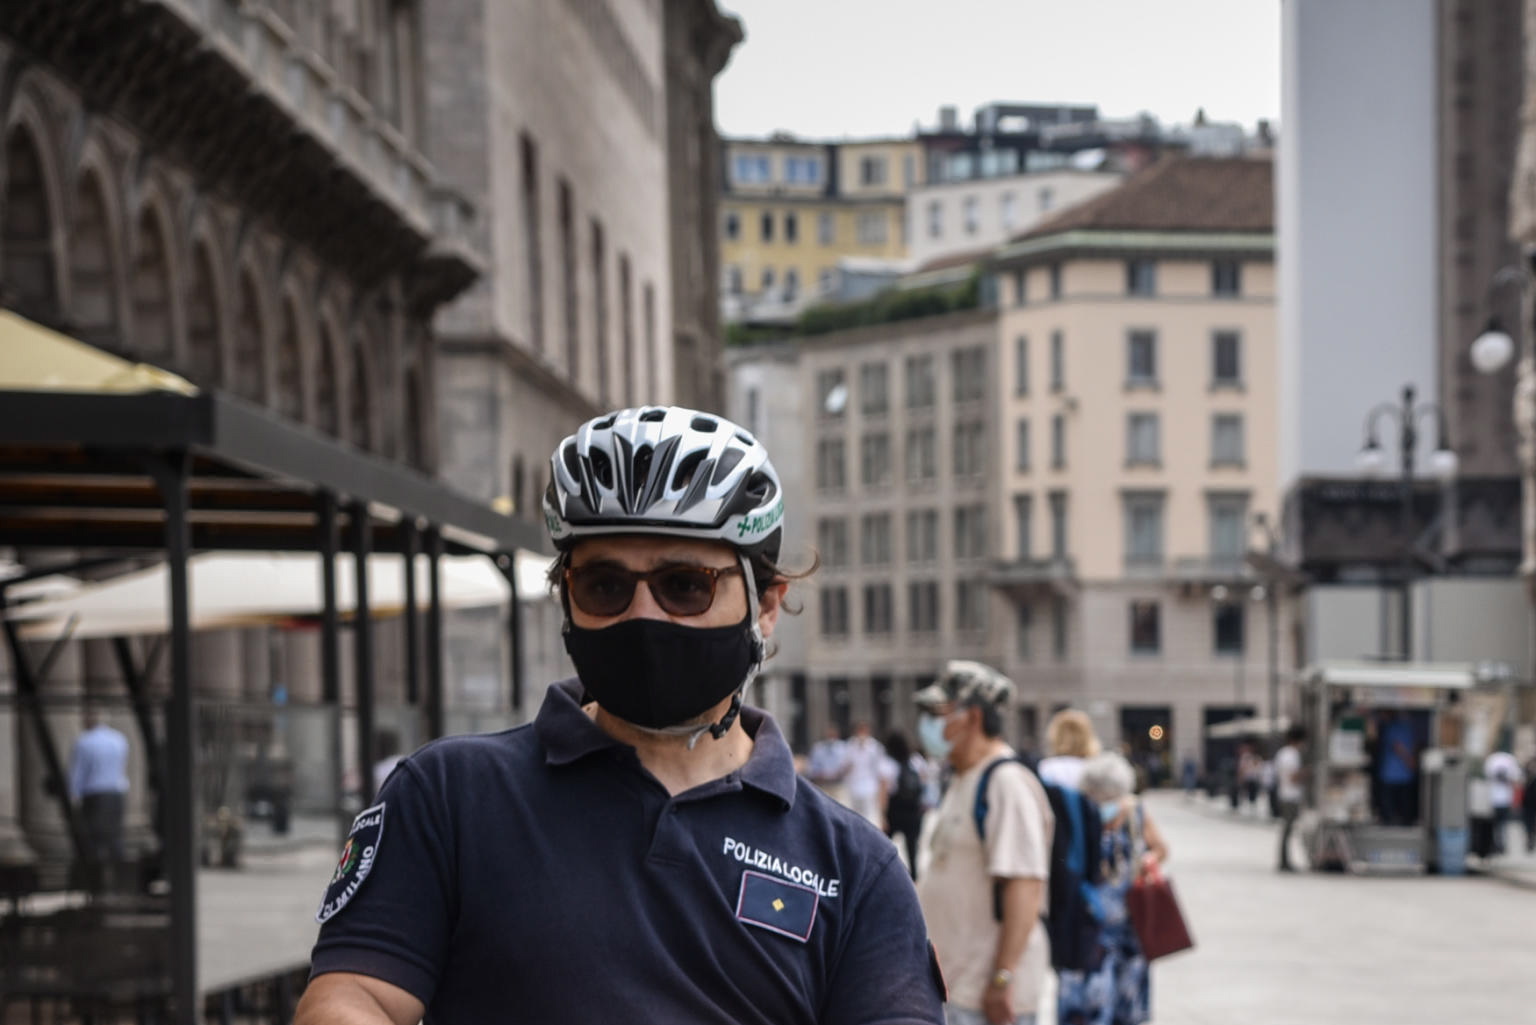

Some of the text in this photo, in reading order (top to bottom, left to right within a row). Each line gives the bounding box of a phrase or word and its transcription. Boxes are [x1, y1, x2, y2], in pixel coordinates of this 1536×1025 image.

[335, 845, 374, 908] MILANO
[723, 837, 840, 897] POLIZIA LOCALE
